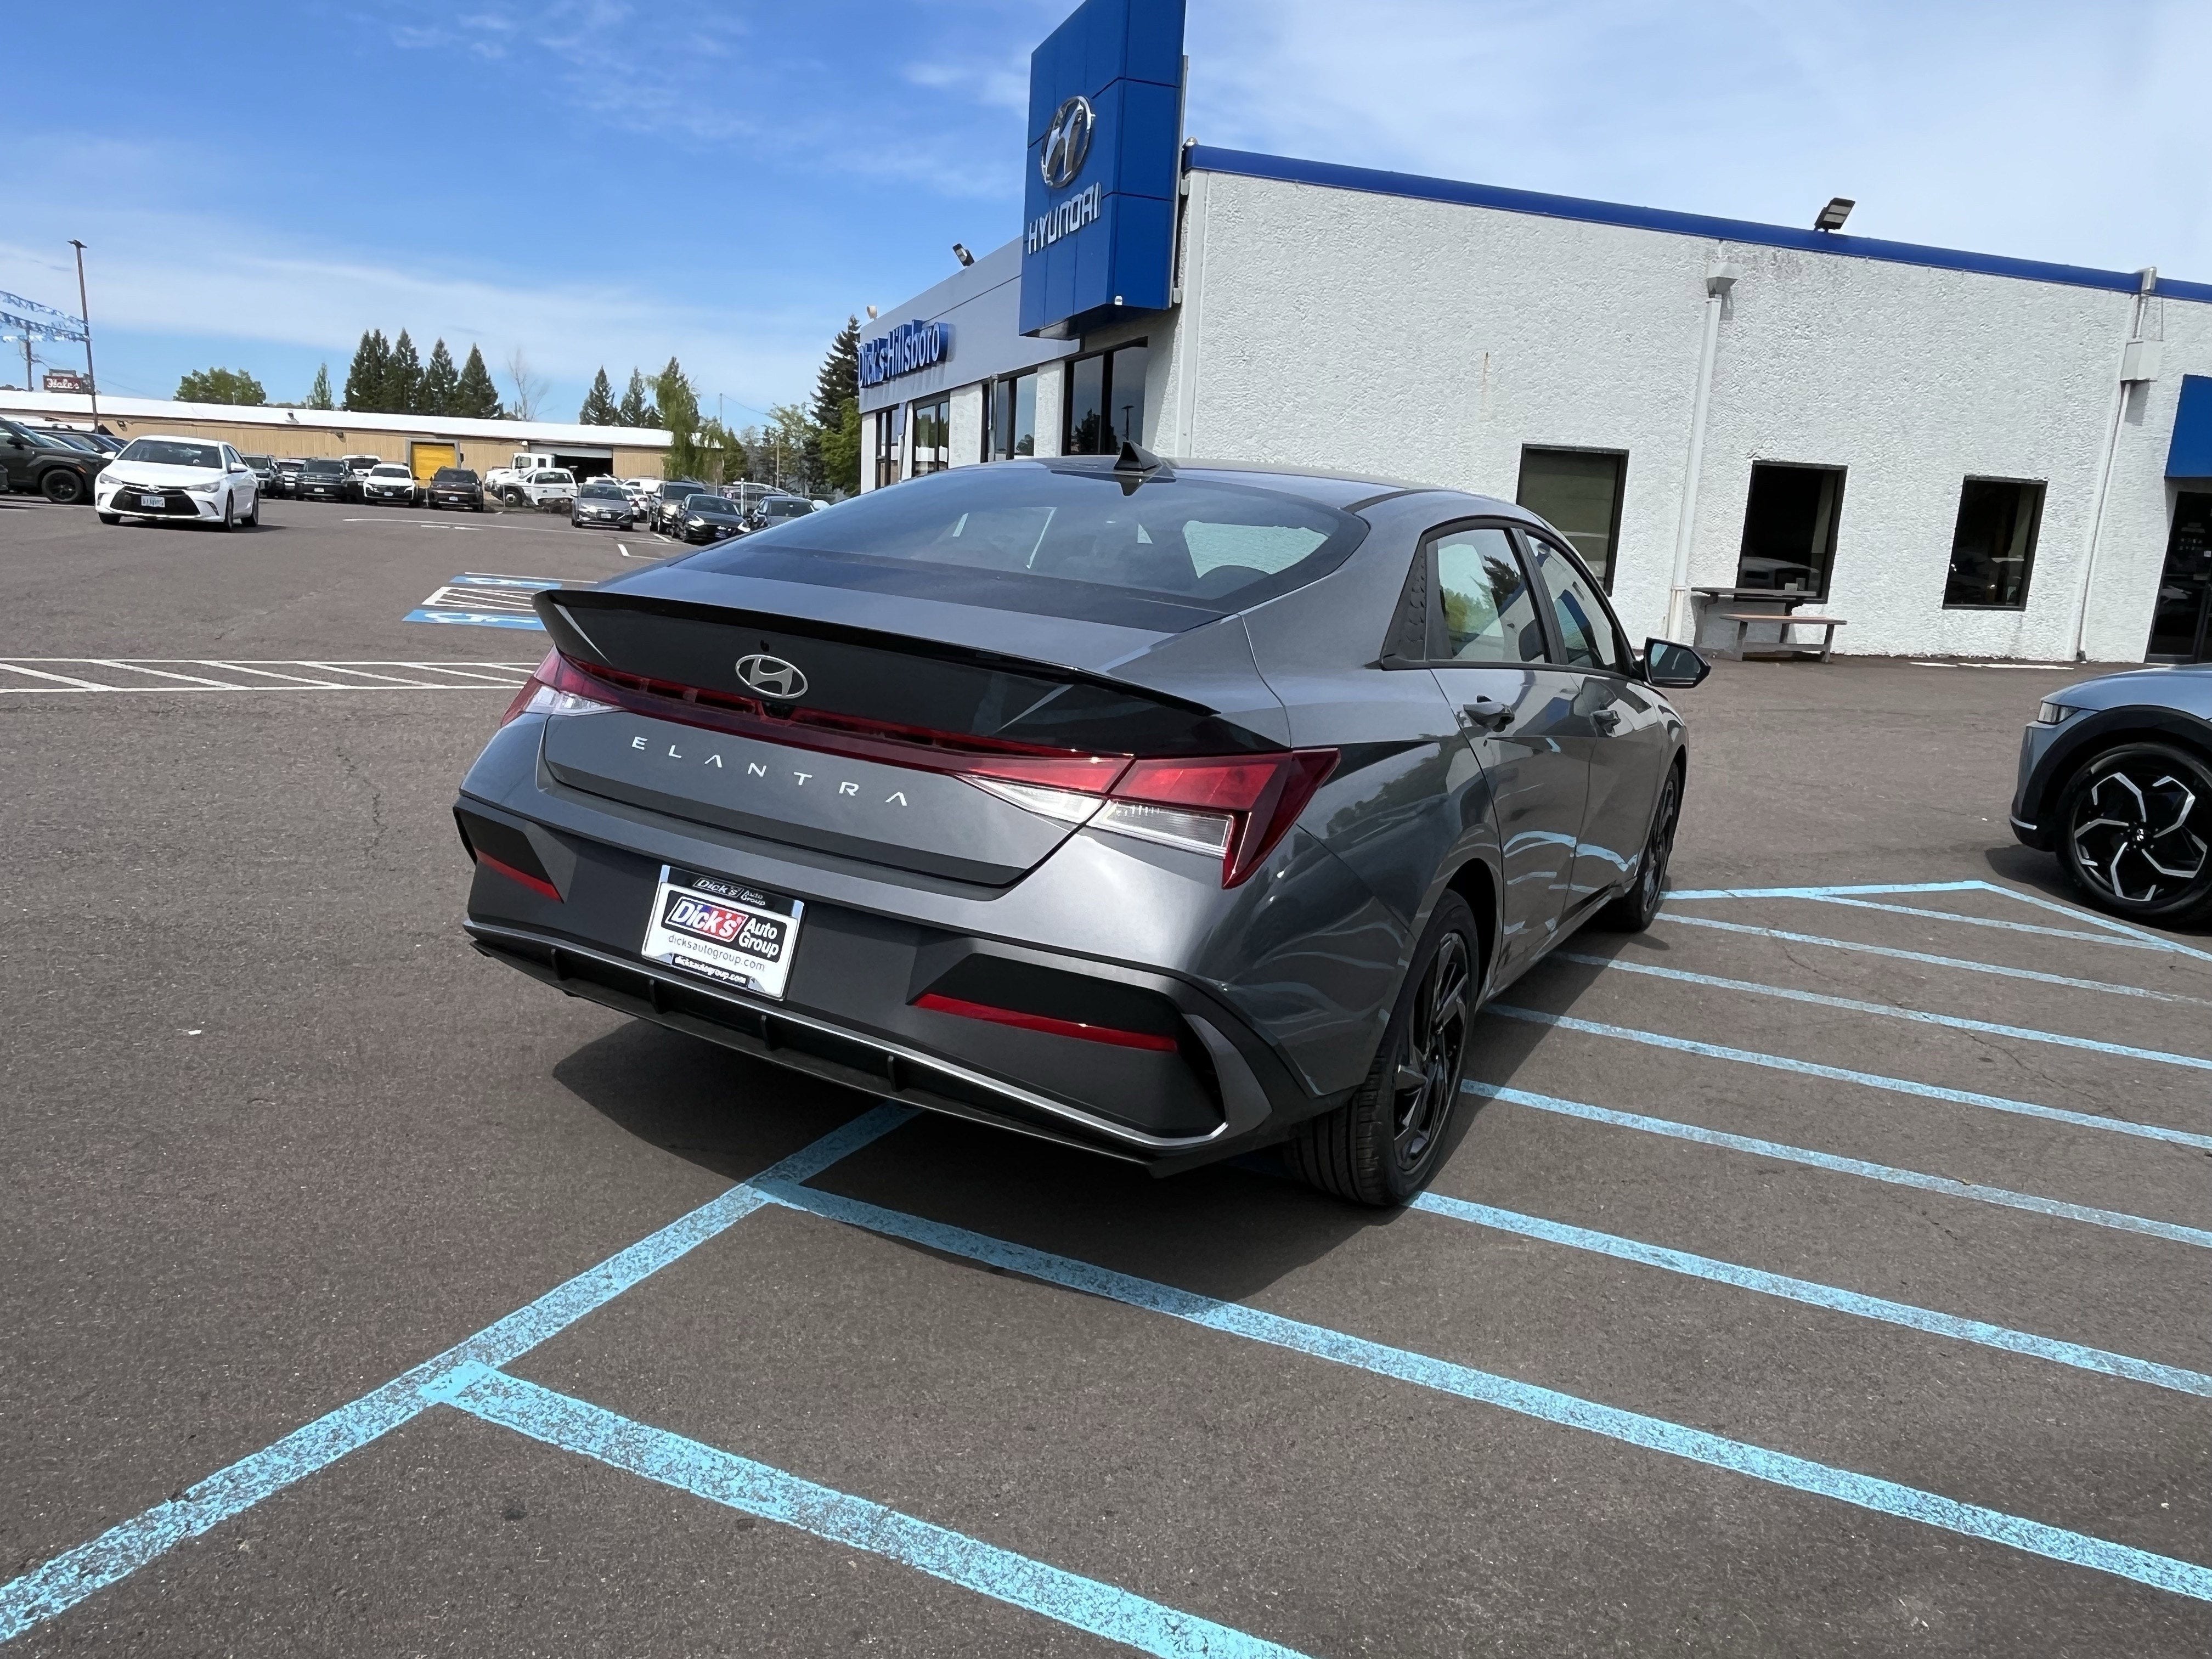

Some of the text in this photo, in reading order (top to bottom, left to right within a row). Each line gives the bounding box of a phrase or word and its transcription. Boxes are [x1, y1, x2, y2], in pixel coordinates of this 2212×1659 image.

[1028, 182, 1102, 255] HYUNDAI
[887, 319, 940, 377] Hillsboro
[631, 736, 908, 807] ELANTRA
[697, 879, 738, 895] Dick's
[740, 894, 766, 906] Group
[743, 890, 763, 900] Auto
[671, 900, 737, 938] Dick's
[743, 917, 777, 940] Auto
[668, 934, 765, 971] dicksautogroup.com
[738, 932, 779, 958] Group
